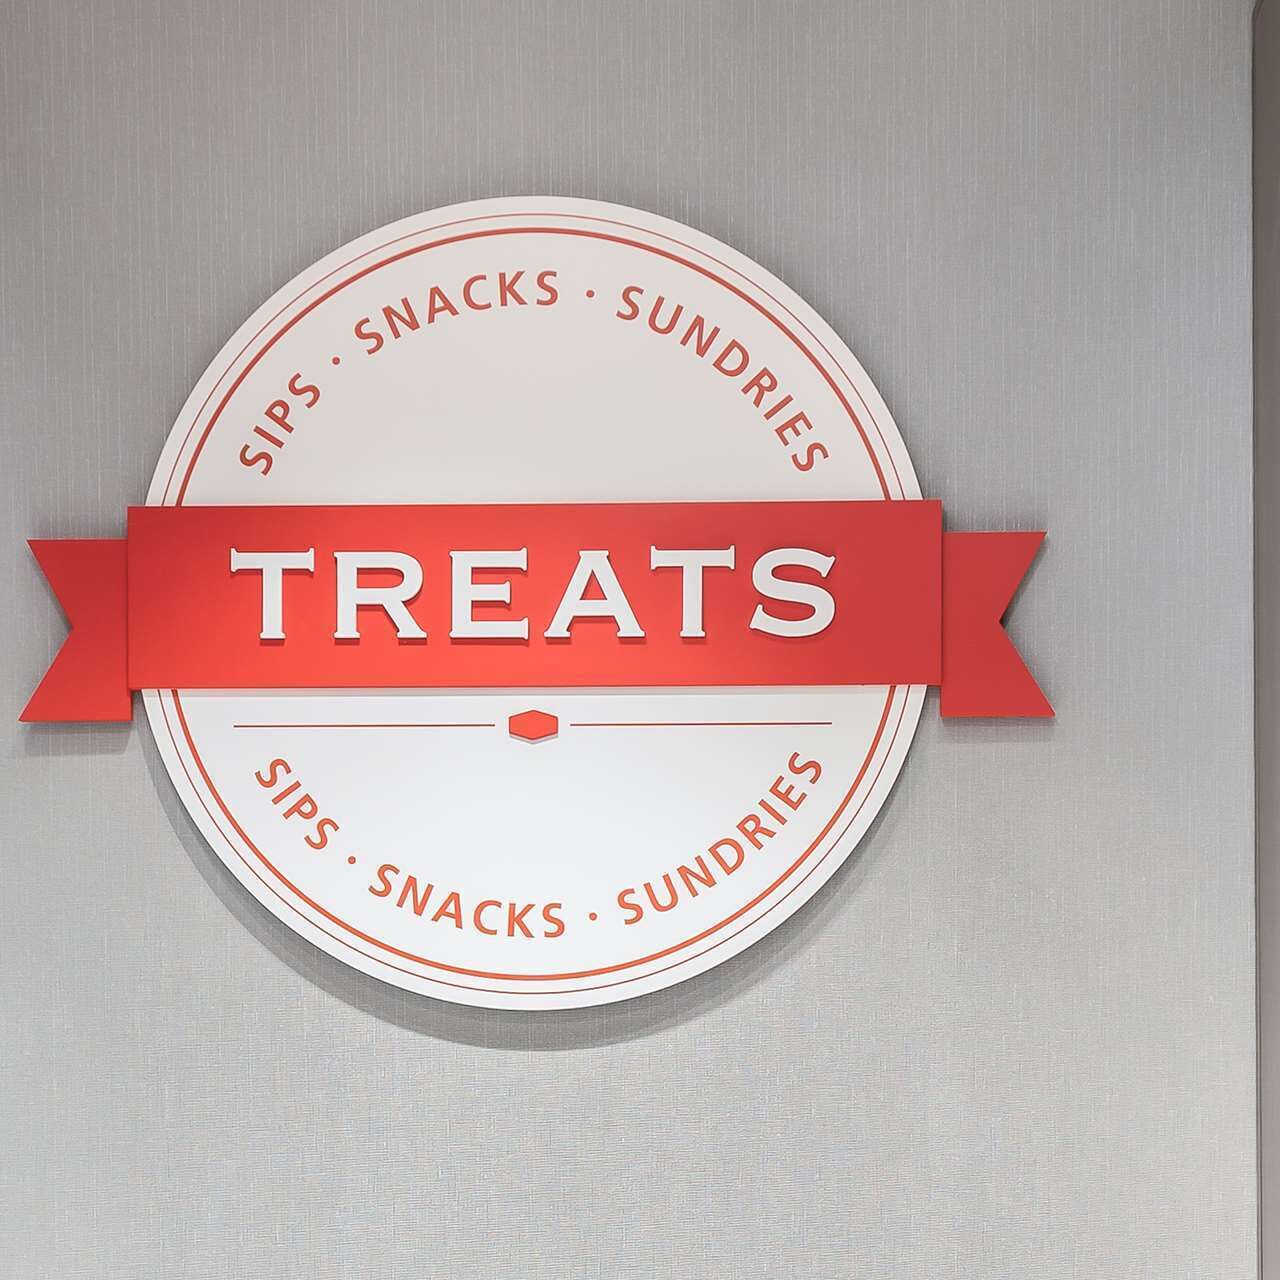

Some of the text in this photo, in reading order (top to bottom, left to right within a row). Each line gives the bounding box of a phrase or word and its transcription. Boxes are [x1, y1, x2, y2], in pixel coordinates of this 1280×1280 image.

[240, 270, 830, 476] SIPS SNACKS SUNDRIES
[230, 545, 838, 642] TREATS
[255, 750, 824, 939] SIPS SNACKS SUNDRIES
